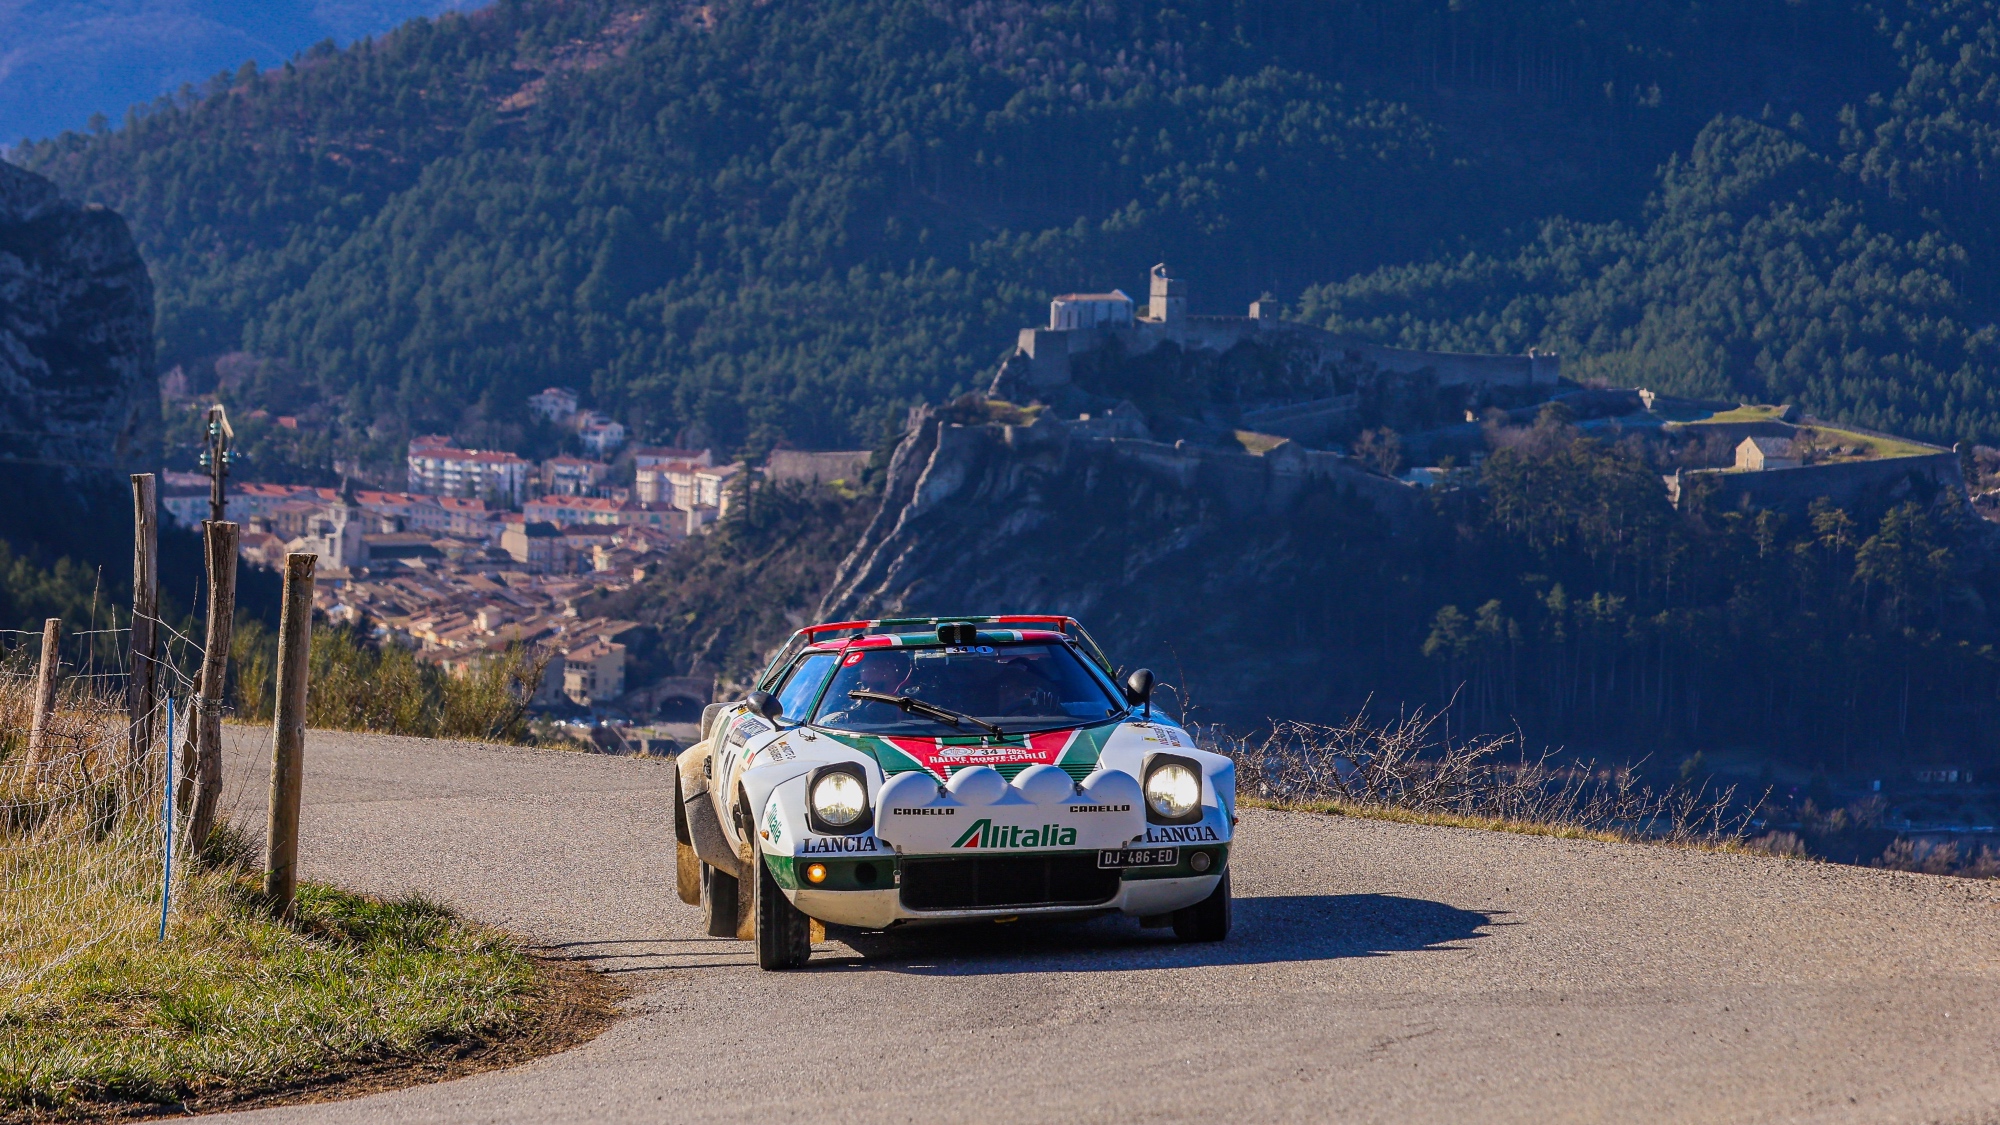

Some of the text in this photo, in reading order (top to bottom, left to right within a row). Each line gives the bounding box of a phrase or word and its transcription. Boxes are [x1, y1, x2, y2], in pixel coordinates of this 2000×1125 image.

[929, 755, 968, 764] RALLYE
[970, 750, 1047, 763] MONTE-CARLO
[1070, 804, 1130, 813] CARELLO
[951, 819, 1077, 848] Alitalia
[1146, 825, 1219, 843] LANCIA
[802, 836, 877, 854] LANCIA
